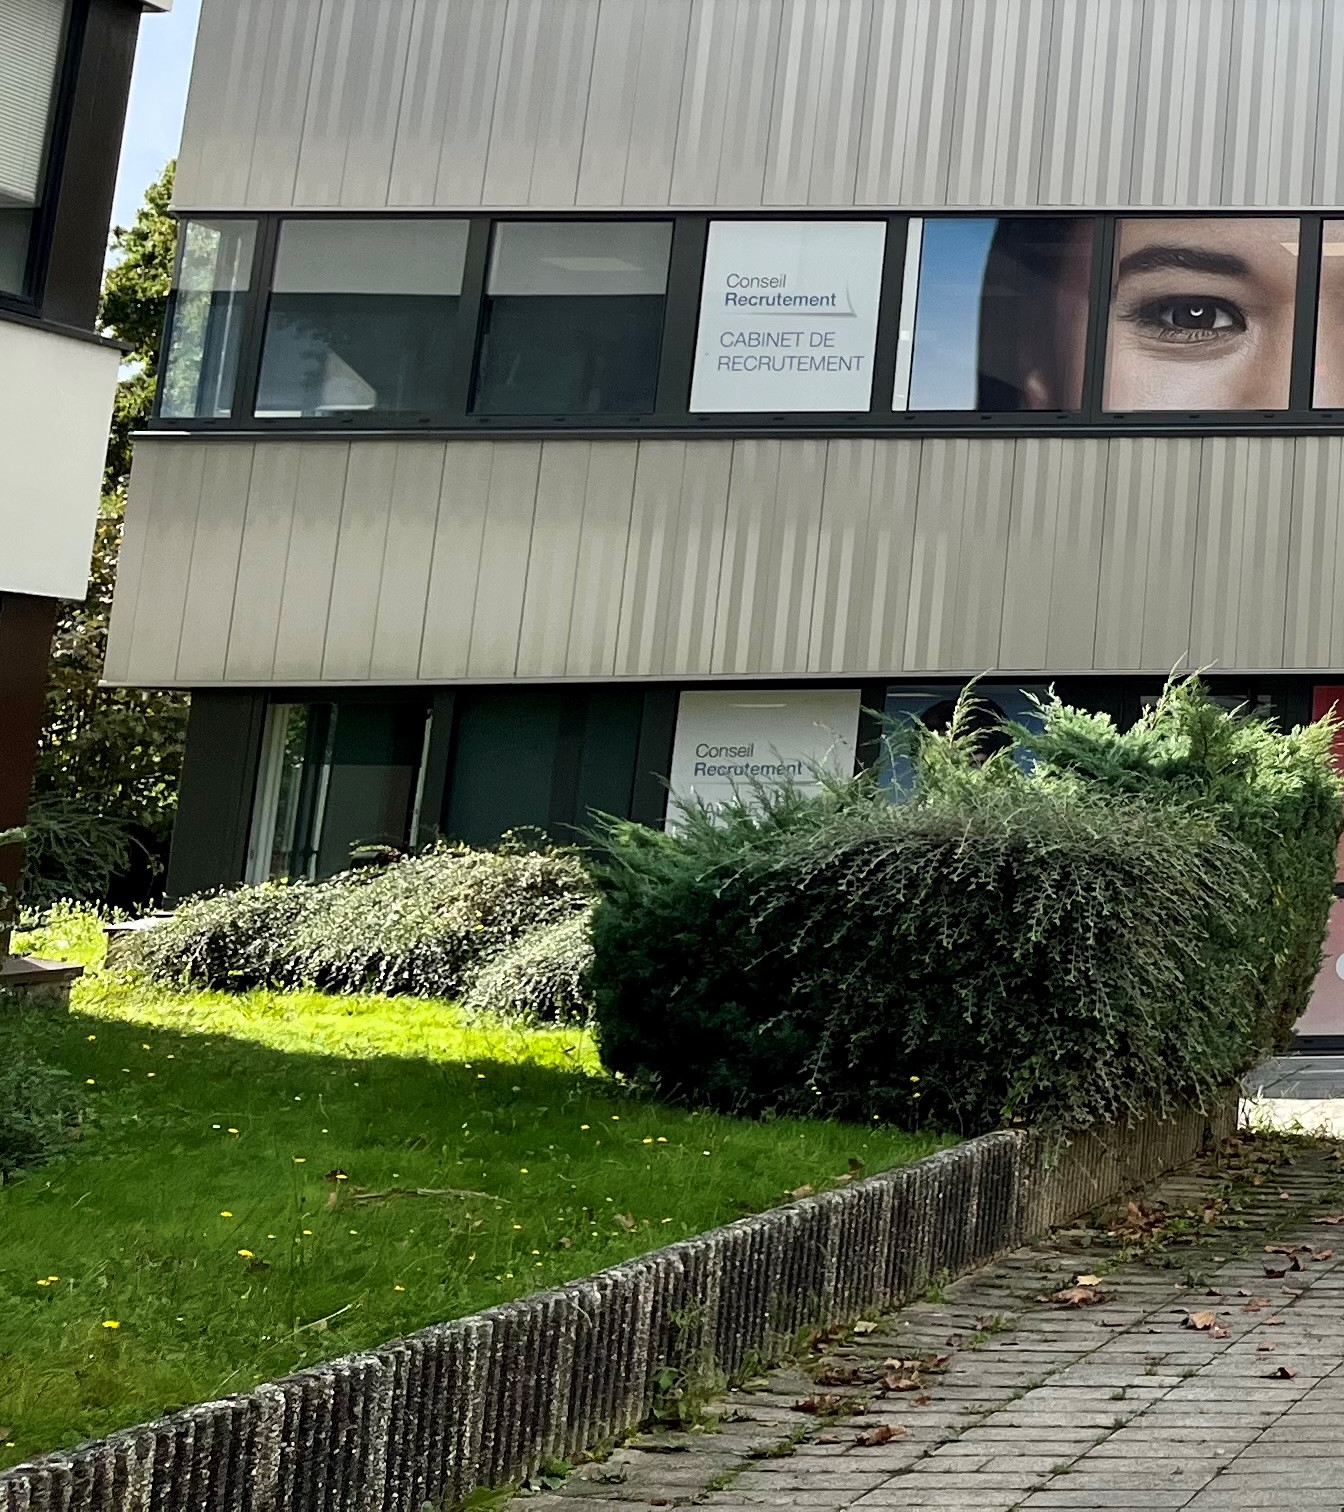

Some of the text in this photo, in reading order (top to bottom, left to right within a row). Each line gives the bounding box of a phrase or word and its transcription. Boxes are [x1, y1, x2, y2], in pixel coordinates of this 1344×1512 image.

[726, 273, 787, 288] Conseil
[724, 292, 837, 306] Recrutement
[719, 331, 836, 348] CABINET DE
[717, 355, 865, 371] RECRUTEMENT
[695, 743, 754, 758] Conseil
